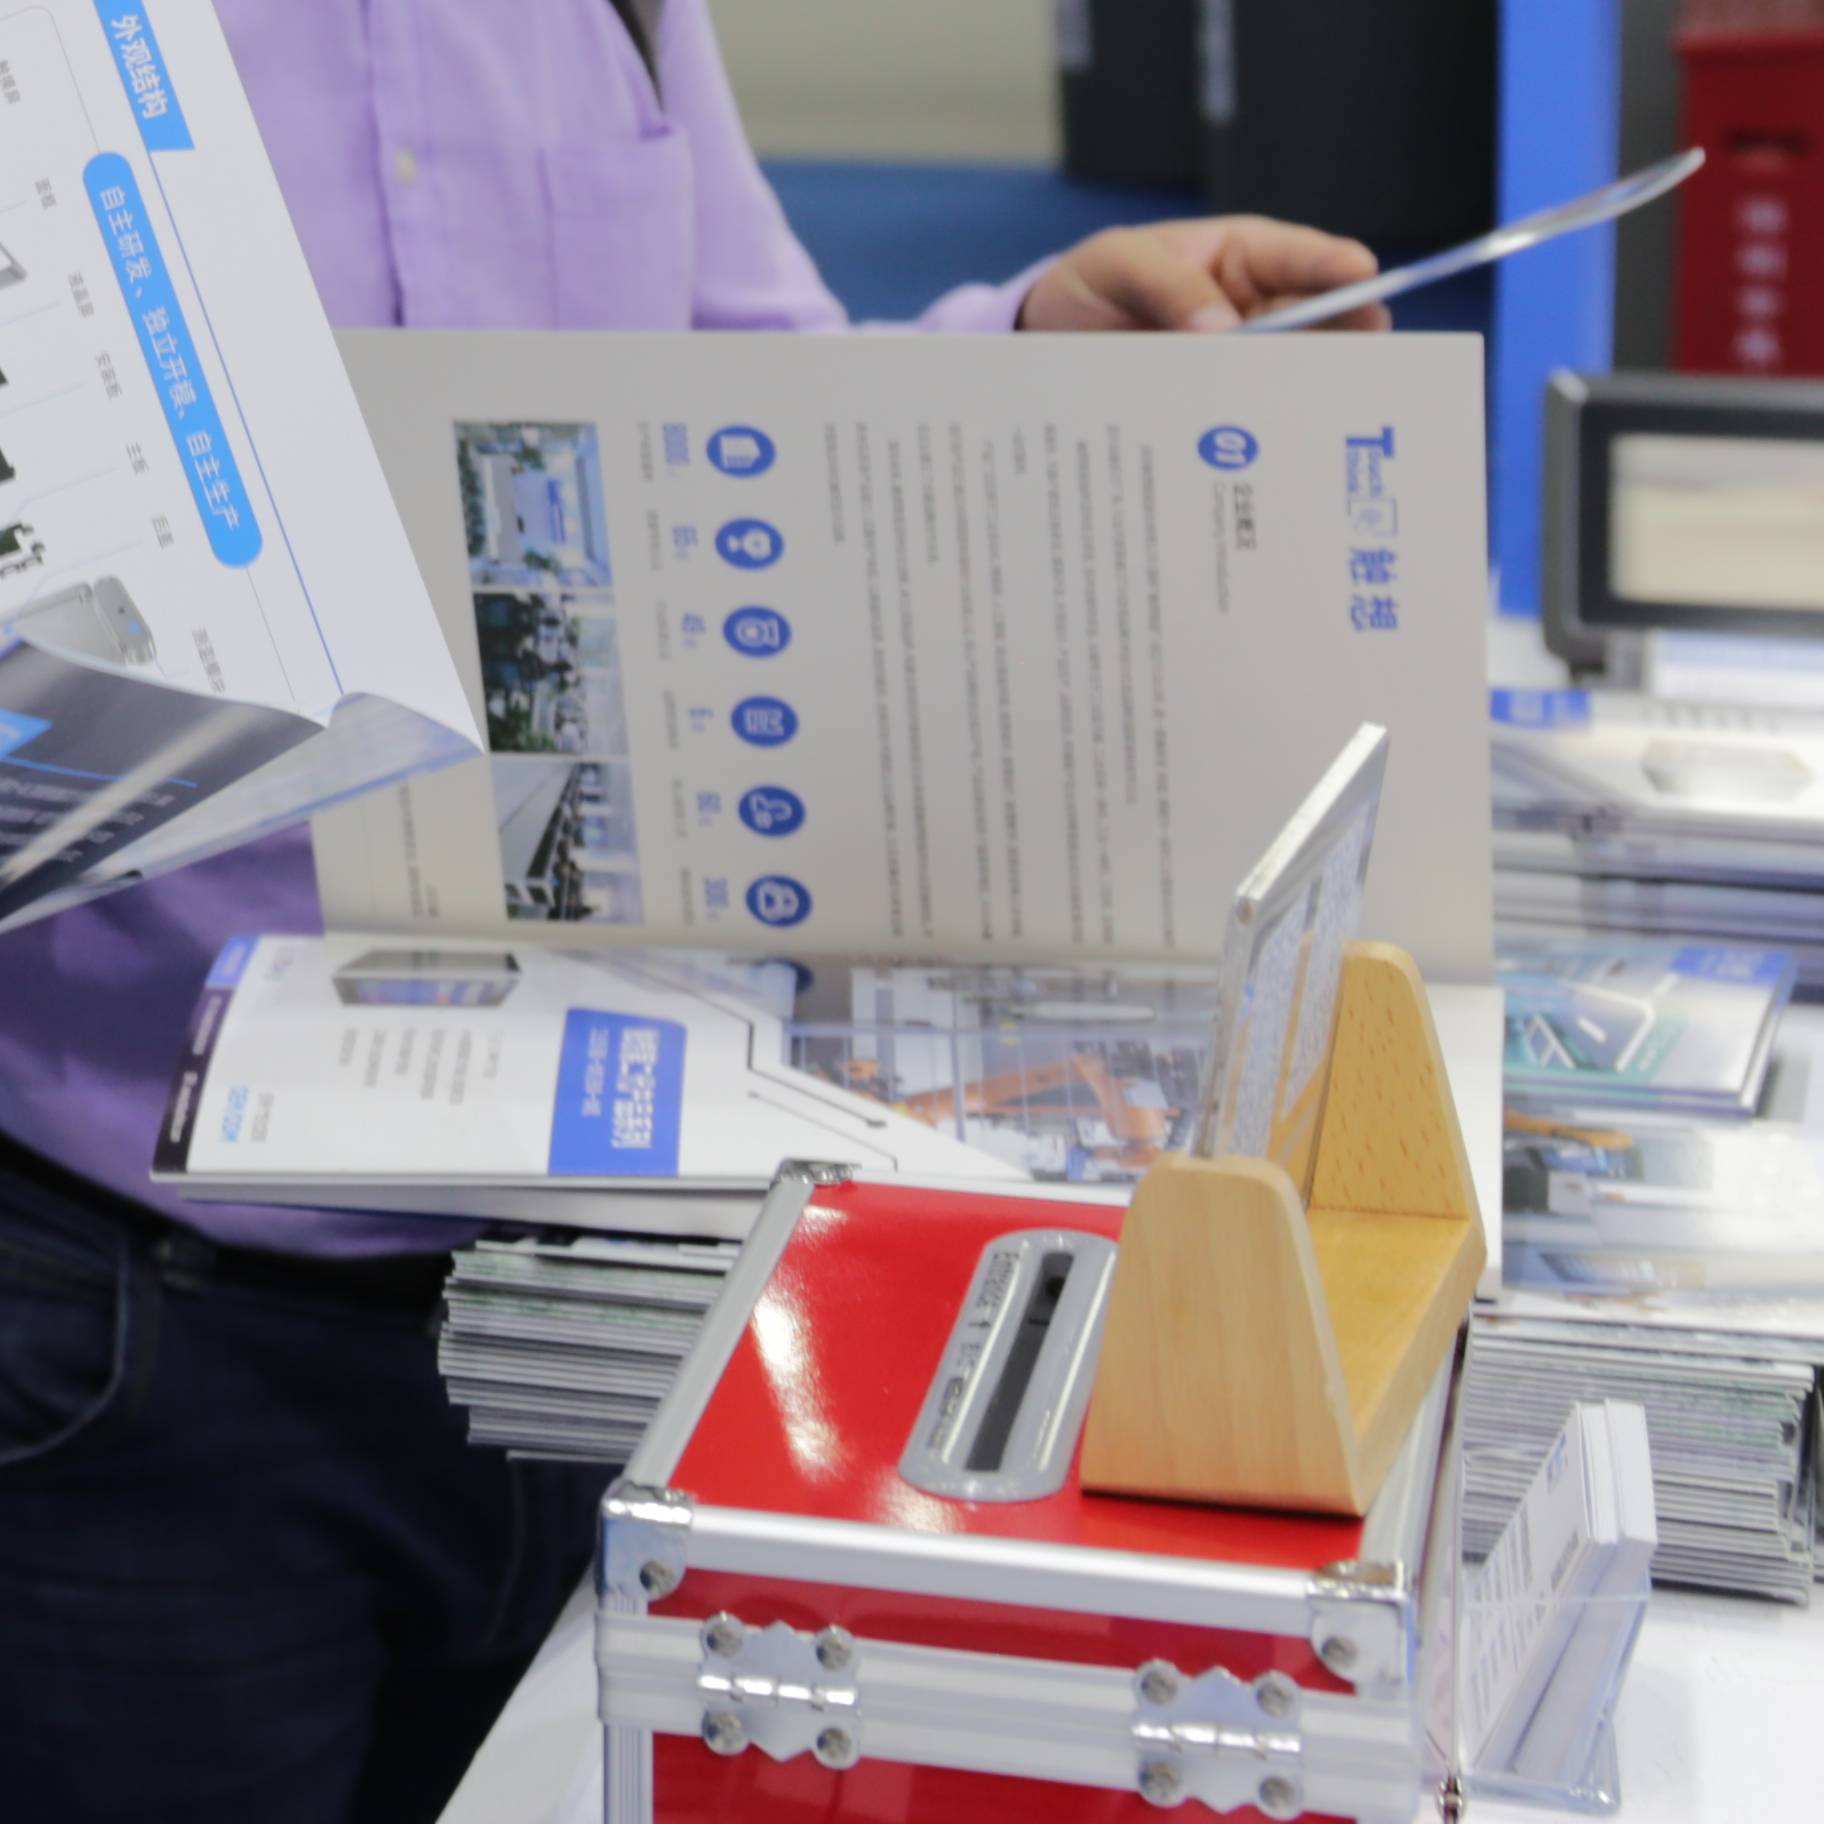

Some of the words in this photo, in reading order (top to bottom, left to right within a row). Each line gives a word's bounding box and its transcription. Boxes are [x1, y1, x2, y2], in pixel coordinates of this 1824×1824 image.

[107, 11, 171, 120] 外观结构
[96, 183, 242, 536] 自主研发、独立开模、自主生产
[1212, 431, 1248, 464] 01
[1346, 547, 1401, 632] 触想
